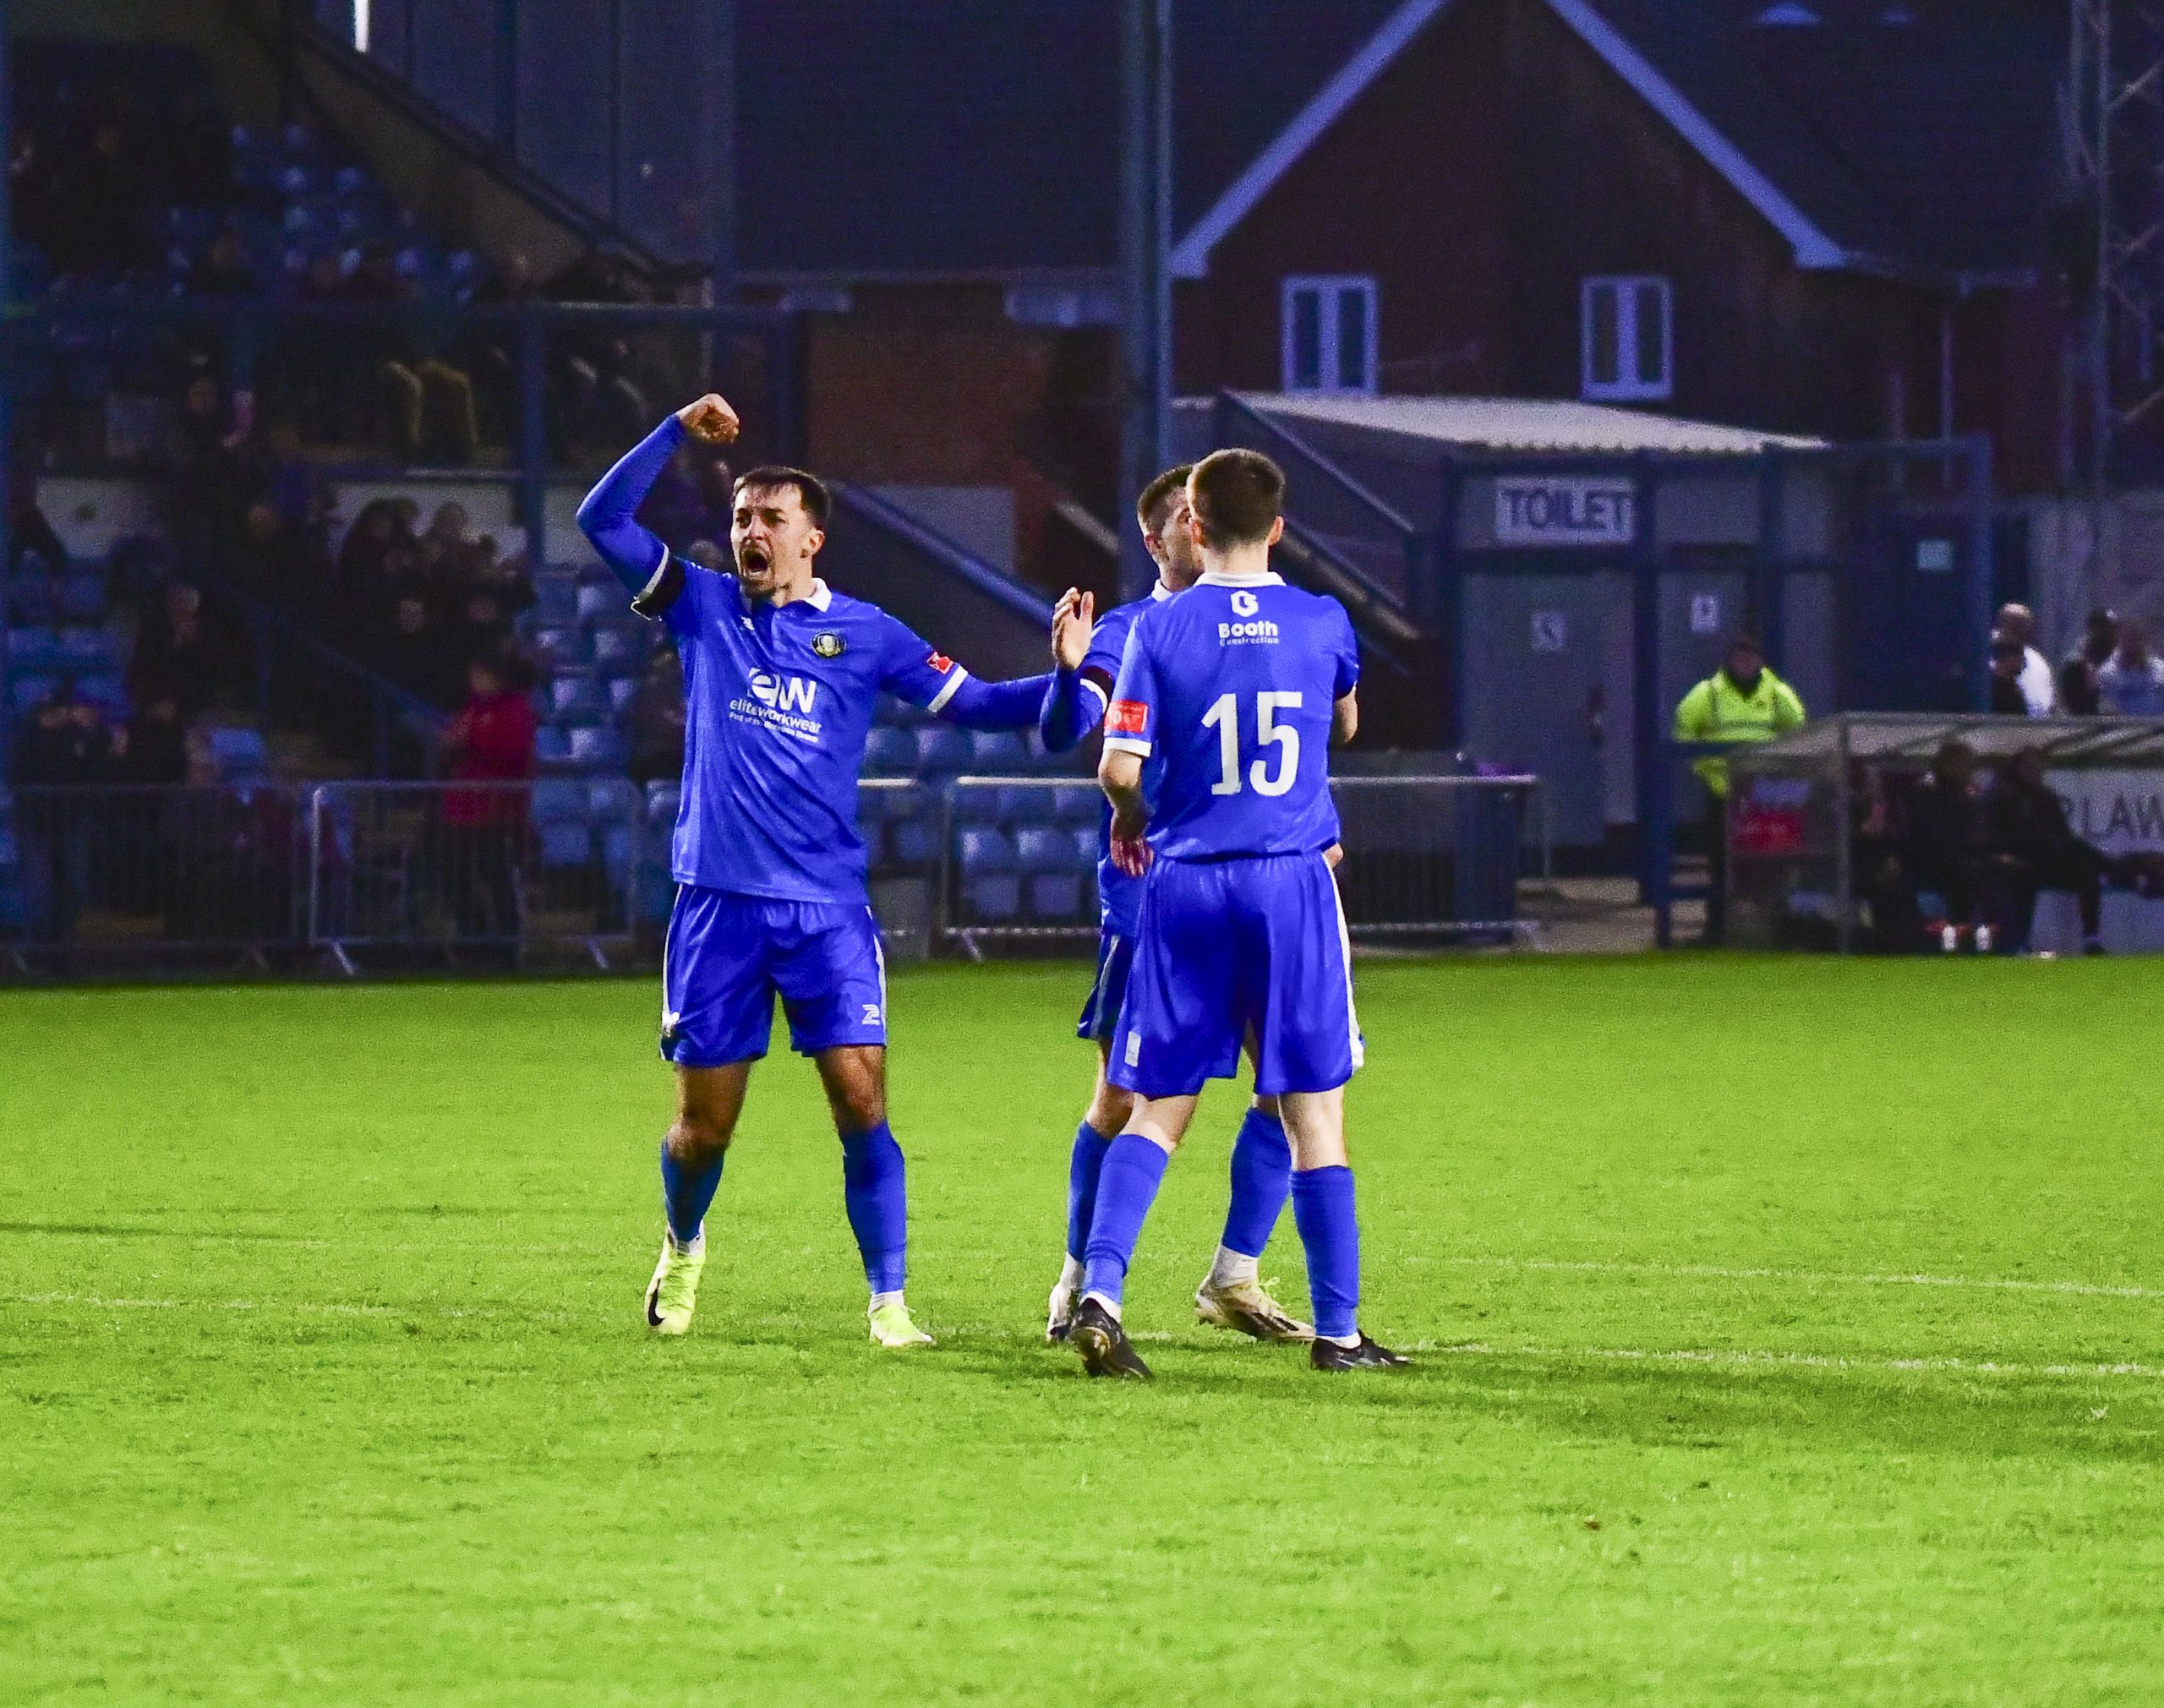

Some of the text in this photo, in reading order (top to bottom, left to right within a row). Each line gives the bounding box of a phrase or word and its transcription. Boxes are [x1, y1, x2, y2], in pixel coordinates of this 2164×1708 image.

[1501, 488, 1632, 530] TOILET
[1218, 620, 1278, 639] Booth
[1200, 691, 1303, 797] 15
